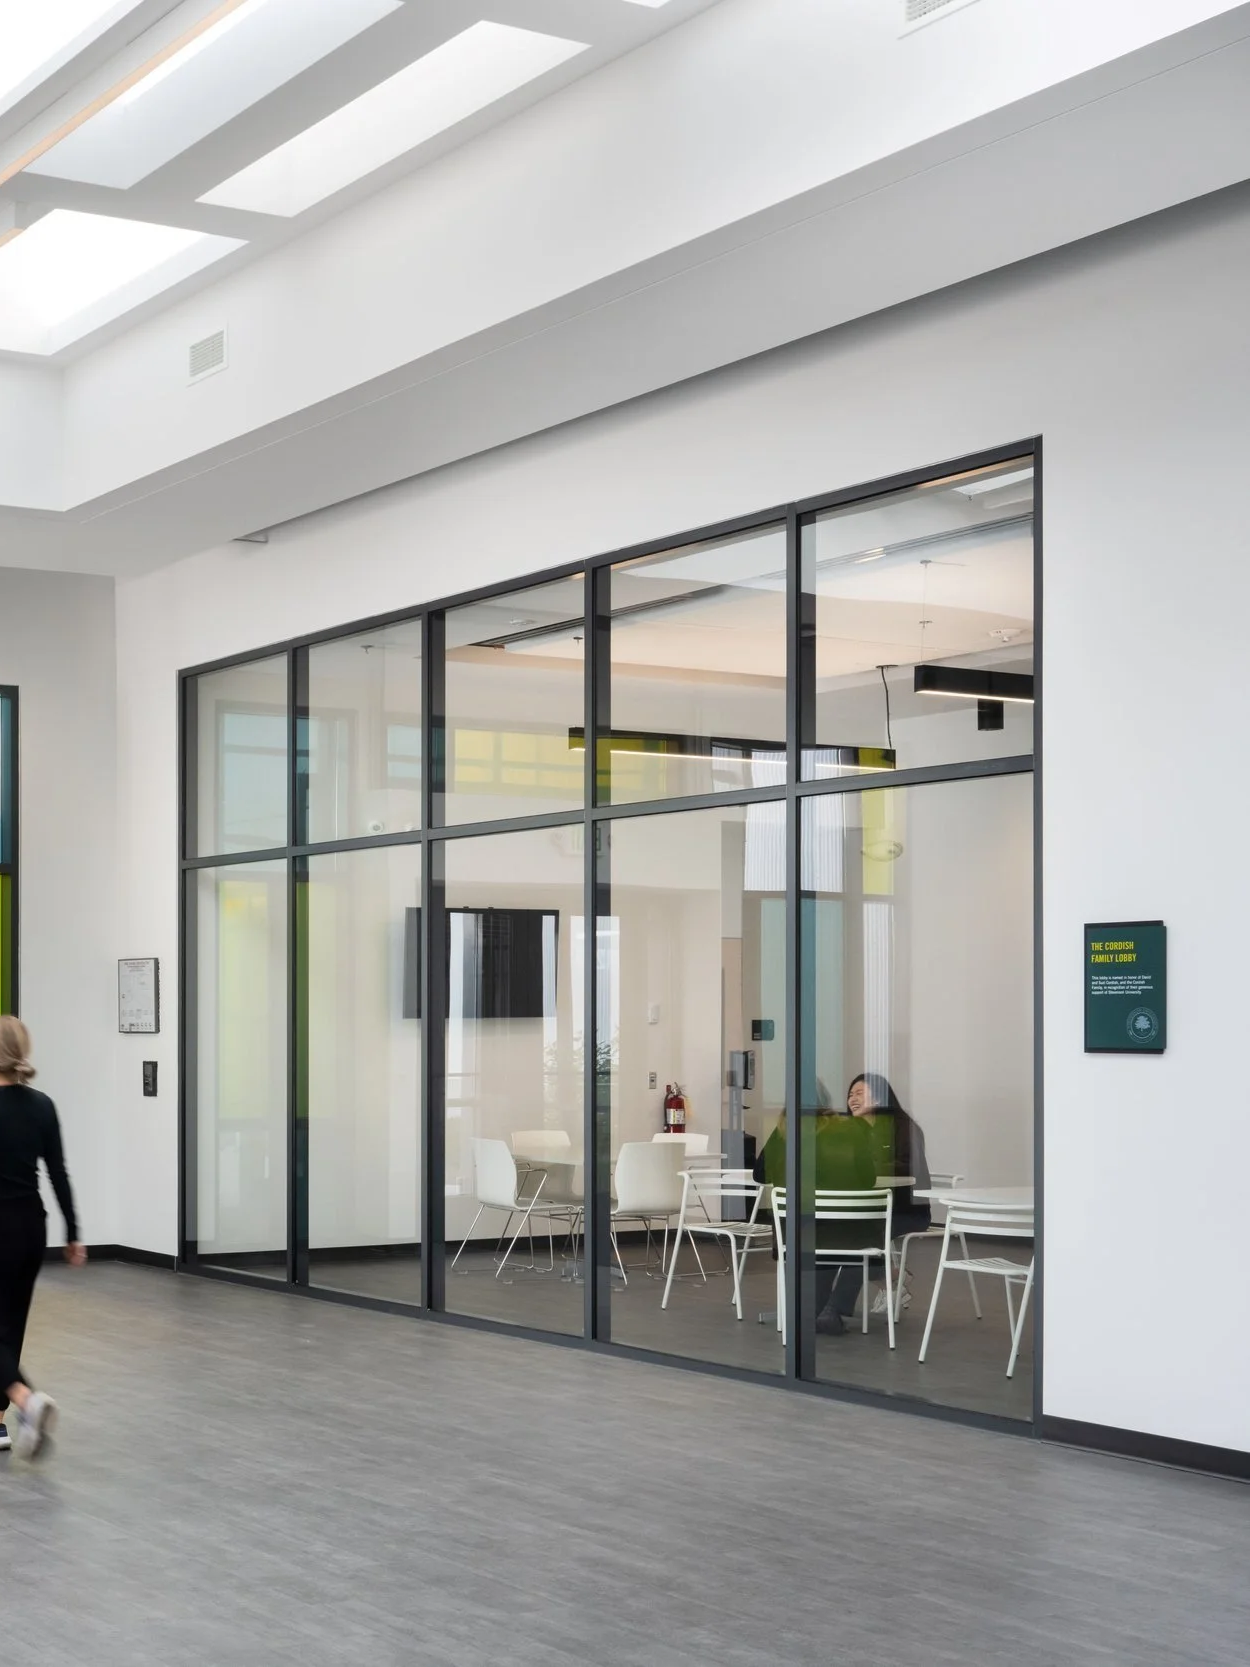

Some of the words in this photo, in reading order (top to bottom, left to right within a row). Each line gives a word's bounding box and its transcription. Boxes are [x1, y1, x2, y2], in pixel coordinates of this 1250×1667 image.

[1091, 942, 1103, 951] THE
[1105, 941, 1134, 951] CORDISH
[1091, 954, 1114, 963] FAMILY
[1115, 953, 1137, 963] LOBBY
